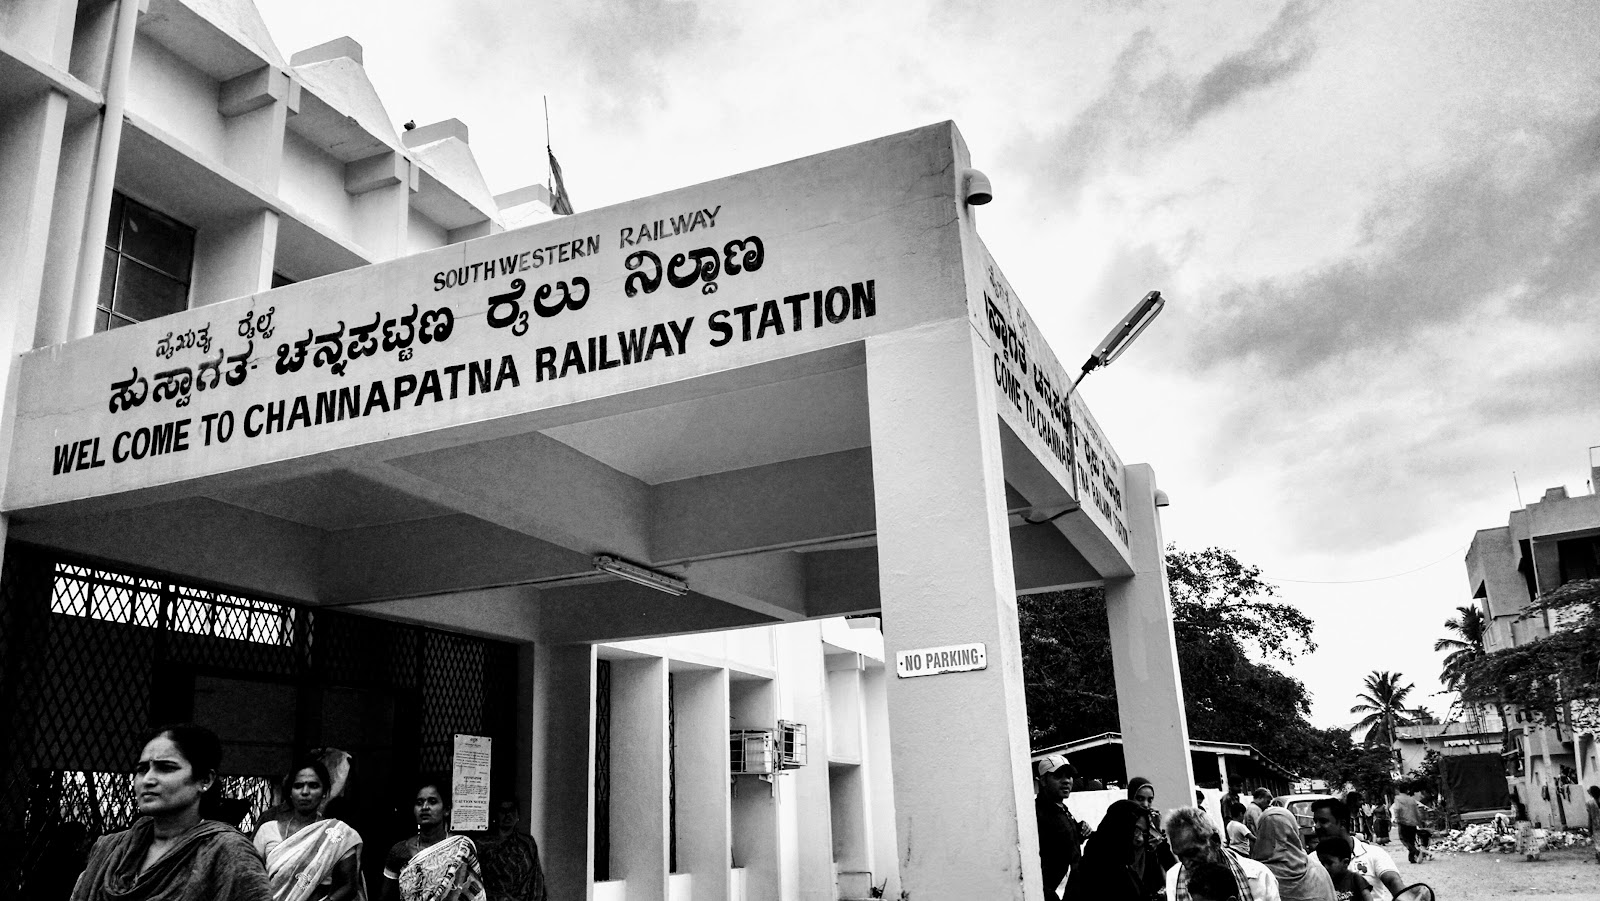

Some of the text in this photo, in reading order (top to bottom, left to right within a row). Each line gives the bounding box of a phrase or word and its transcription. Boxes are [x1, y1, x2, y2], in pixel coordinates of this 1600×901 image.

[619, 205, 721, 249] RAILWAY
[275, 304, 454, 377] ಚನ್ನಪಟ್ಟಣ
[486, 278, 590, 337] ರೈಲು
[624, 236, 765, 298] ನಿಲ್ದಾಣ
[201, 409, 235, 447] TO
[243, 355, 520, 438] CHANNAPATNA
[535, 317, 695, 383] RAILWAY
[708, 279, 877, 347] STATION
[994, 352, 1022, 413] COME
[1023, 389, 1036, 429] TO
[904, 648, 979, 672] NO PARKING
